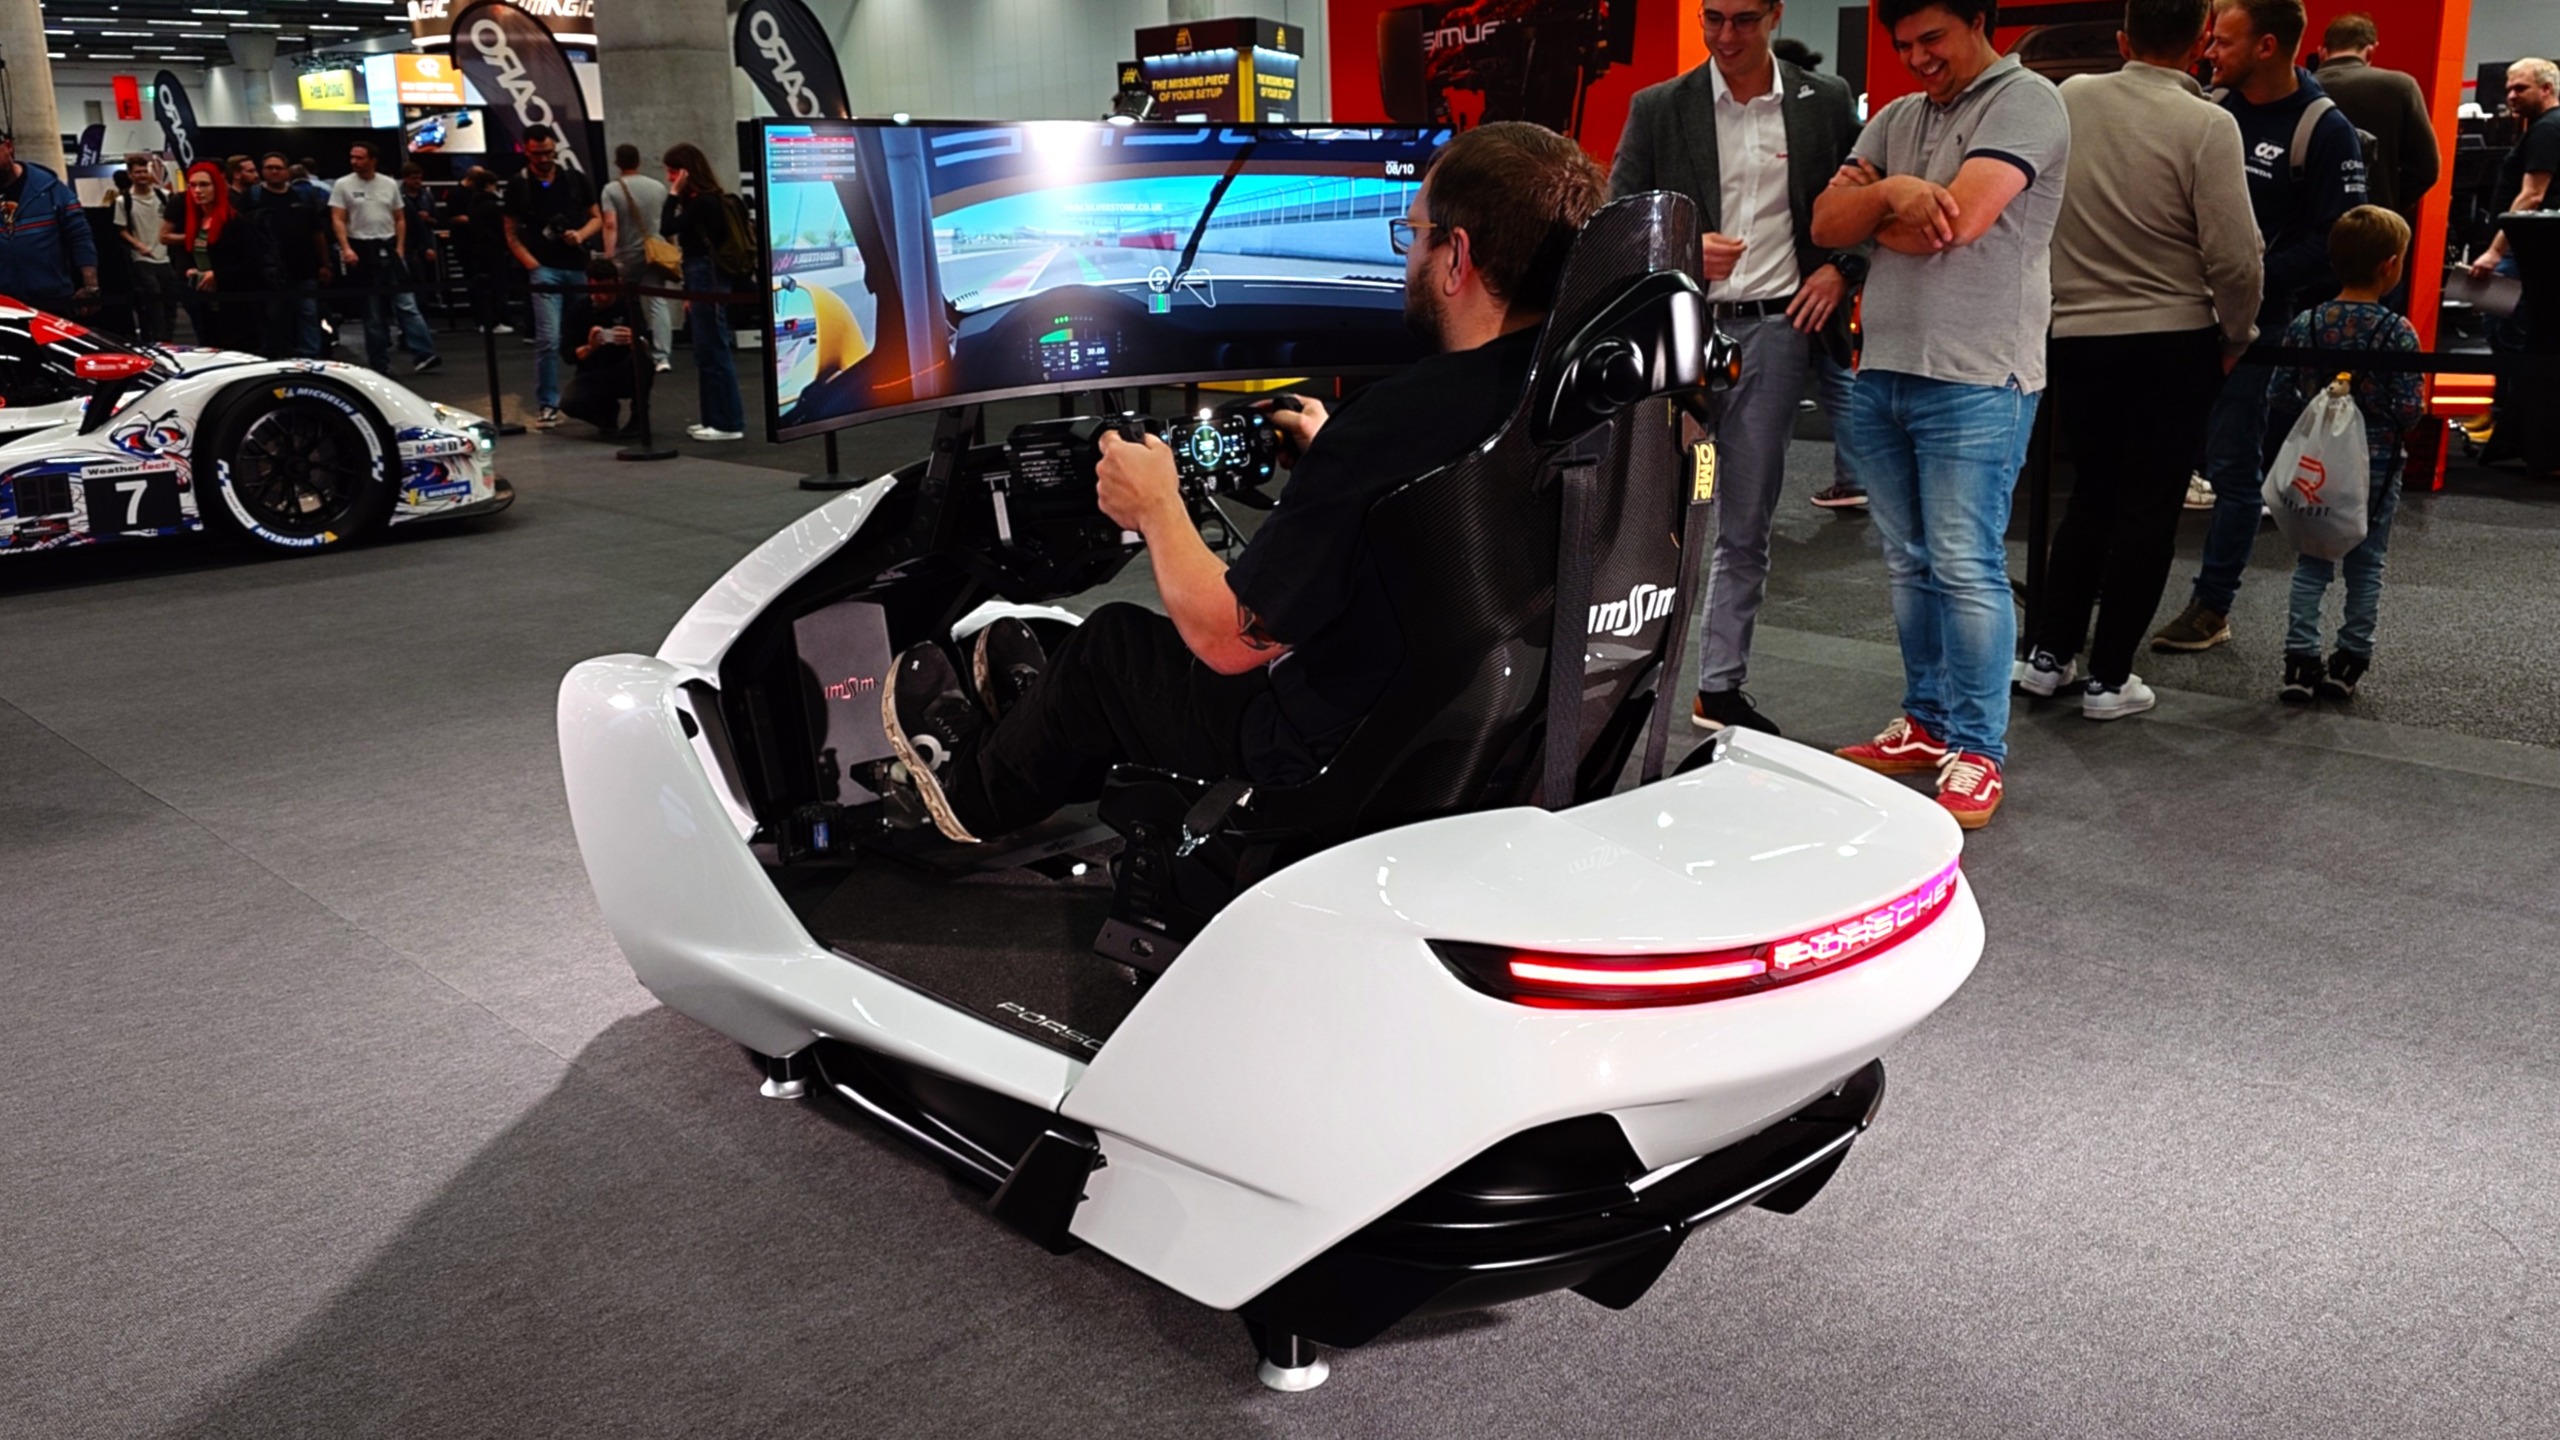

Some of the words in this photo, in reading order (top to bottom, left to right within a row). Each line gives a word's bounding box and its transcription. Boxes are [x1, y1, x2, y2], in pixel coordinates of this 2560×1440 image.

[1152, 79, 1167, 91] THE
[1168, 76, 1204, 89] MISSING
[1205, 73, 1230, 86] PIECE
[1159, 91, 1171, 102] OF
[1172, 89, 1195, 101] YOUR
[1196, 86, 1223, 99] SETUP
[1070, 349, 1080, 363] 5
[296, 387, 353, 414] MICHELIN
[1696, 443, 1713, 500] OMP
[115, 480, 148, 525] 7
[255, 526, 315, 547] MICHELIN
[1775, 879, 1948, 971] PORSCHE
